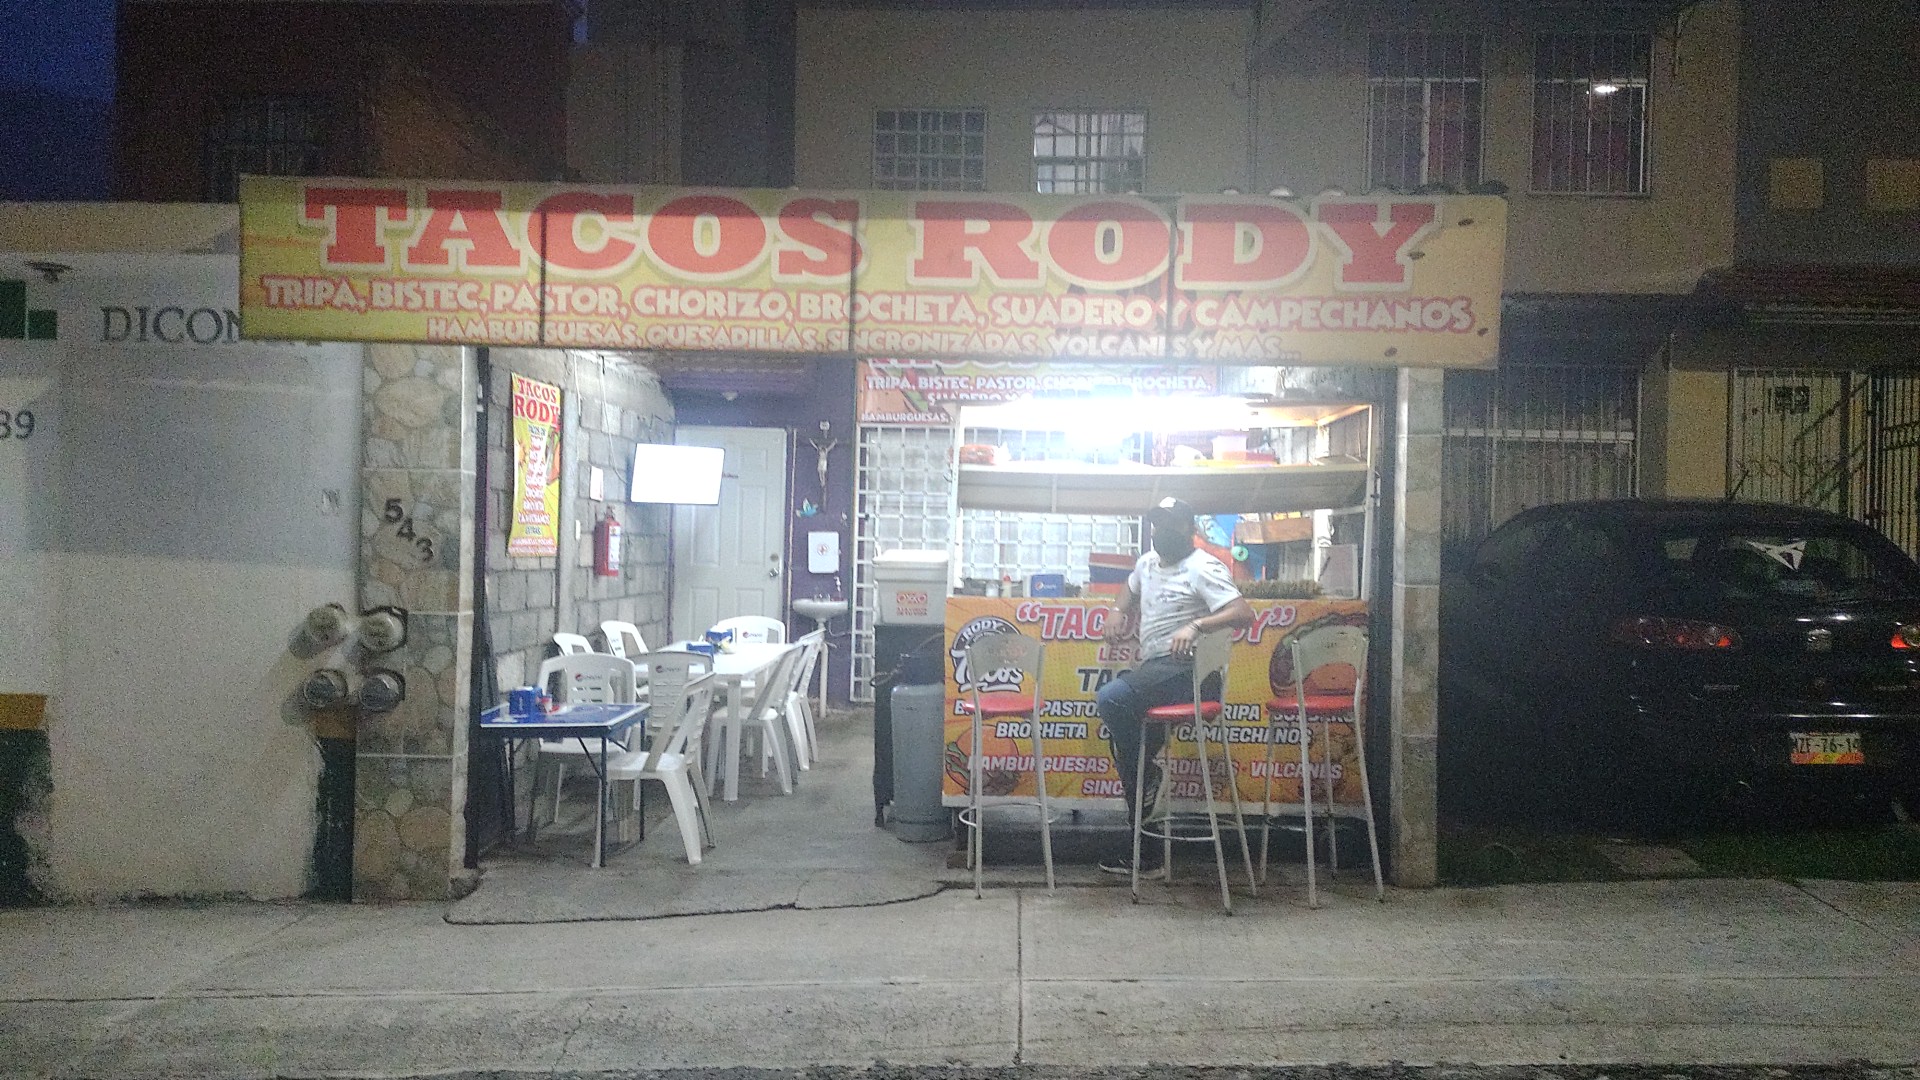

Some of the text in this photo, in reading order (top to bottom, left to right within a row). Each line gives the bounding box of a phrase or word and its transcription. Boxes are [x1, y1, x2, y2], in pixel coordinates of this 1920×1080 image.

[302, 184, 1438, 284] TACOS RODY
[263, 277, 1473, 330] TRIPA, BISTEC, PASTOR, CHORIZO, BROCHETA, SUADERO Y CAMPECHANOS
[517, 378, 557, 404] TACOS
[514, 395, 560, 427] RODY
[384, 499, 434, 562] 543
[1039, 700, 1101, 717] PASTO
[1222, 704, 1261, 722] RIPA
[996, 723, 1088, 739] BROHETA
